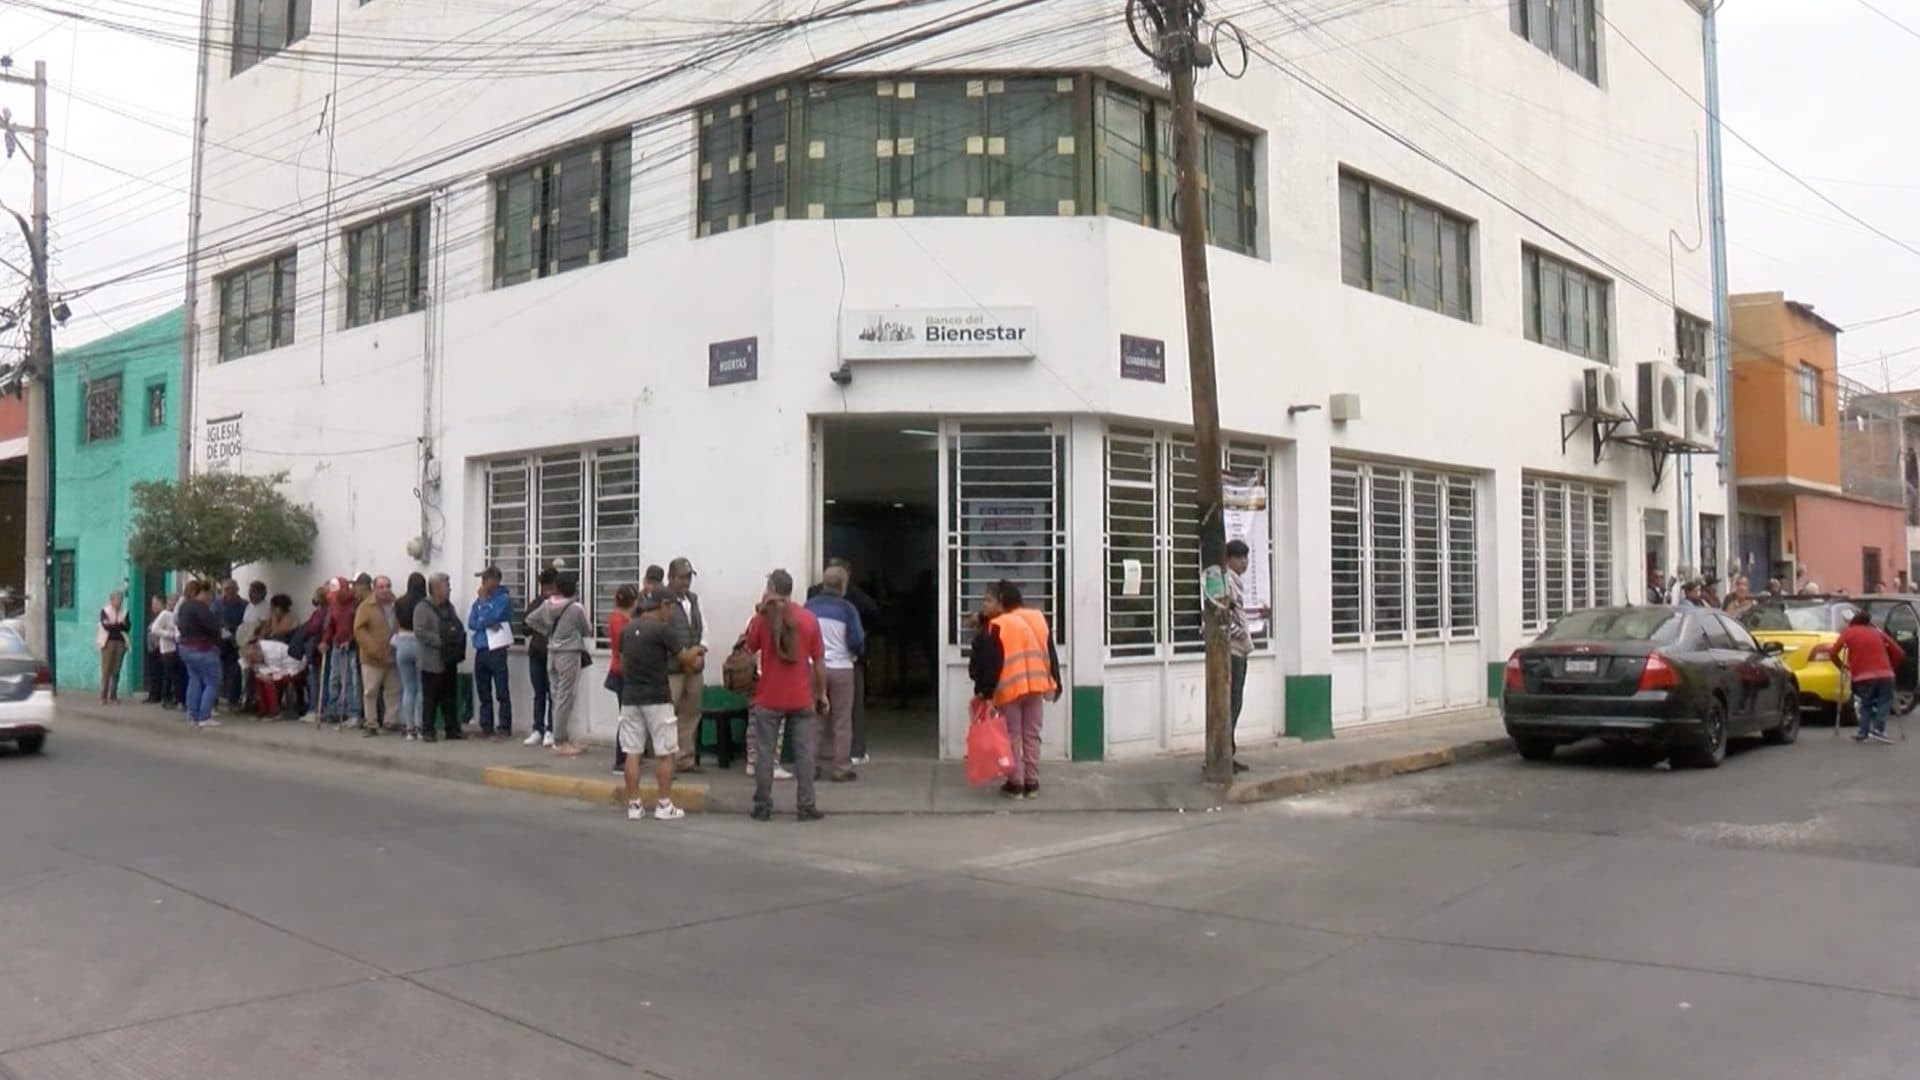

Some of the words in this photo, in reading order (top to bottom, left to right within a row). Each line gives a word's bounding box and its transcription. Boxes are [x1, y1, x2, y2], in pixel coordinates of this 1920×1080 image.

[925, 315, 962, 325] Banco
[965, 314, 984, 324] del
[926, 325, 1026, 341] Bienestar
[207, 423, 240, 442] IGLESIA
[207, 444, 218, 460] DE
[220, 440, 241, 458] DIOS
